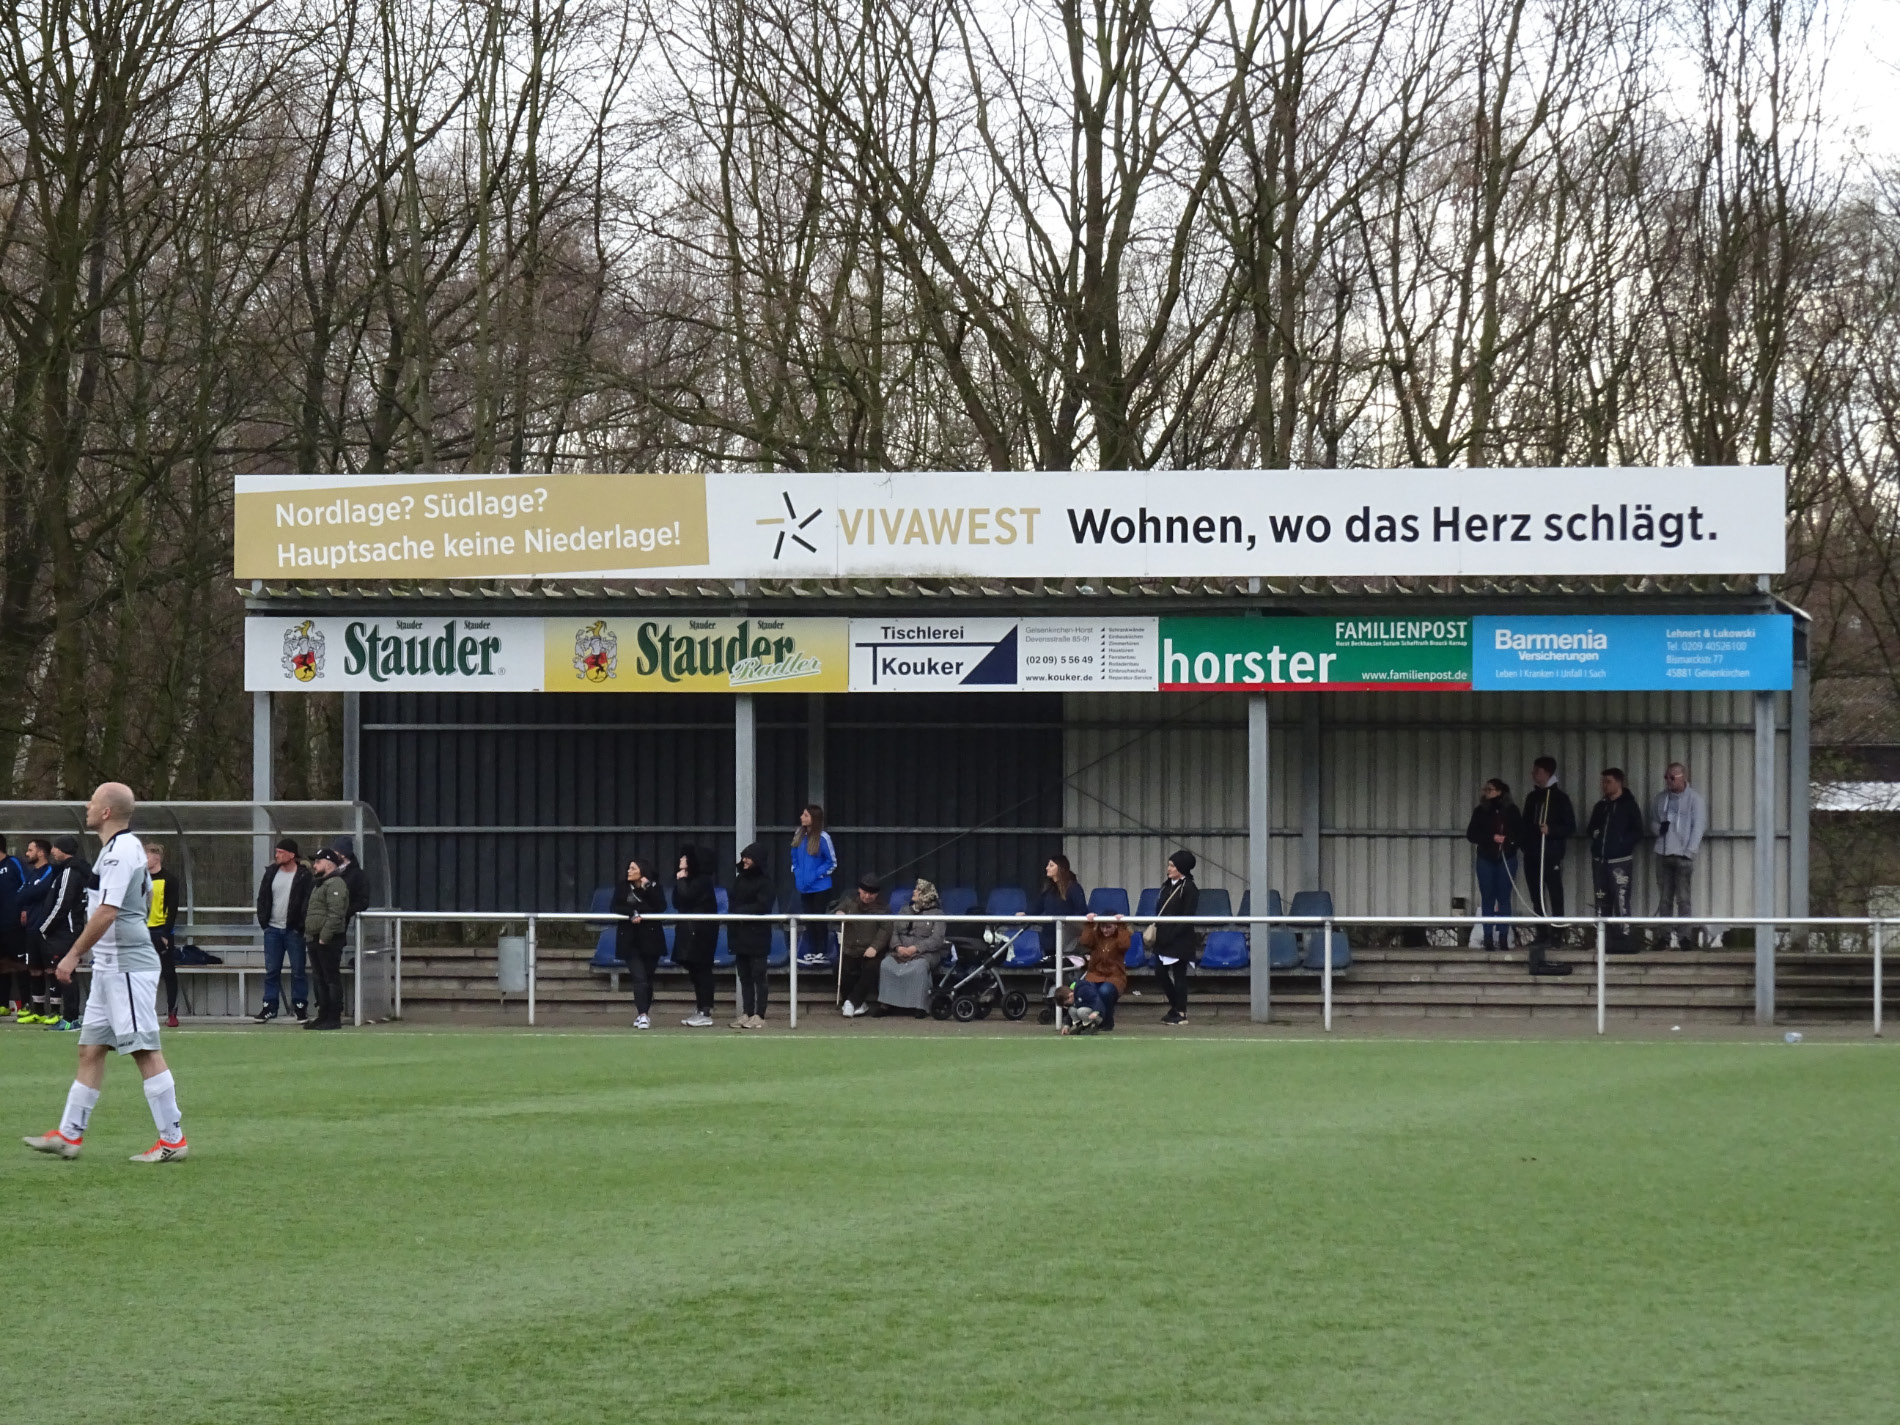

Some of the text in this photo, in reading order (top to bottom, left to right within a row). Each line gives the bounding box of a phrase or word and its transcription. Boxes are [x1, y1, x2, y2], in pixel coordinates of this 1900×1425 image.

[276, 487, 549, 527] Nordlage? Südlage?
[839, 508, 1041, 545] VIVAWEST
[1067, 503, 1718, 550] Wohnen, wo das Herz schlägt.
[277, 521, 681, 569] Hauptsache keine Niederlage!
[881, 626, 964, 640] Tischlerei
[1336, 622, 1467, 639] FAMILIENPOST
[1495, 629, 1607, 649] Barmenia
[1666, 629, 1756, 638] Lehnert & Lukowski
[344, 620, 501, 682] Stauder
[637, 620, 794, 682] Stauder
[1667, 642, 1678, 650] Tel.
[1682, 642, 1702, 650] 0209
[1026, 656, 1040, 665] (02
[1043, 656, 1057, 665] 09)
[1163, 638, 1337, 683] horster
[1518, 651, 1599, 662] Versicherungen
[730, 654, 821, 681] Radler
[882, 657, 964, 676] Kouker
[1362, 669, 1467, 681] www.familienpost.de
[1496, 670, 1606, 678] Leben Kranken Unfall Sach
